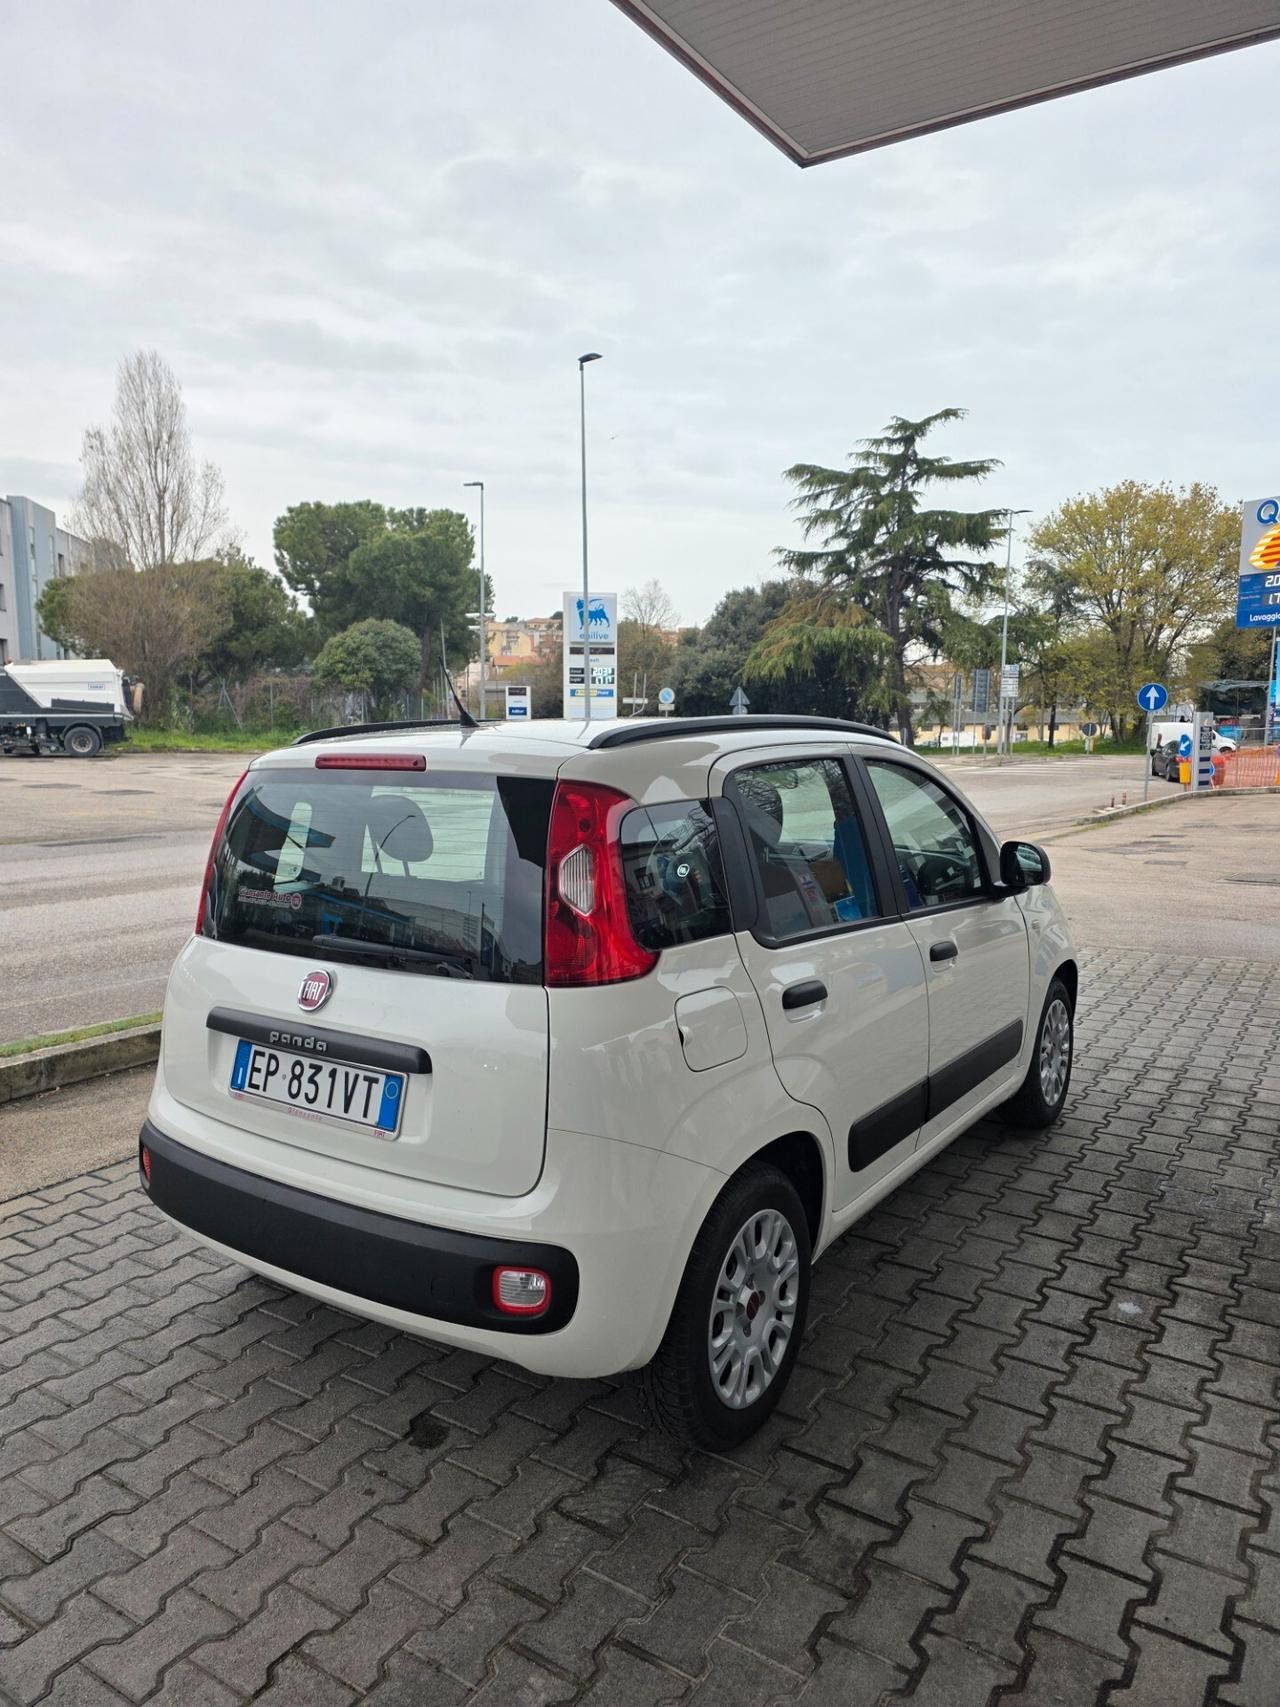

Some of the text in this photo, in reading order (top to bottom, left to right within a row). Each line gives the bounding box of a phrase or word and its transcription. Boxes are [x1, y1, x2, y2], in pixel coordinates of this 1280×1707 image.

[303, 981, 325, 1000] FIAT
[269, 1031, 328, 1052] panda
[248, 1050, 380, 1119] EP 831VT
